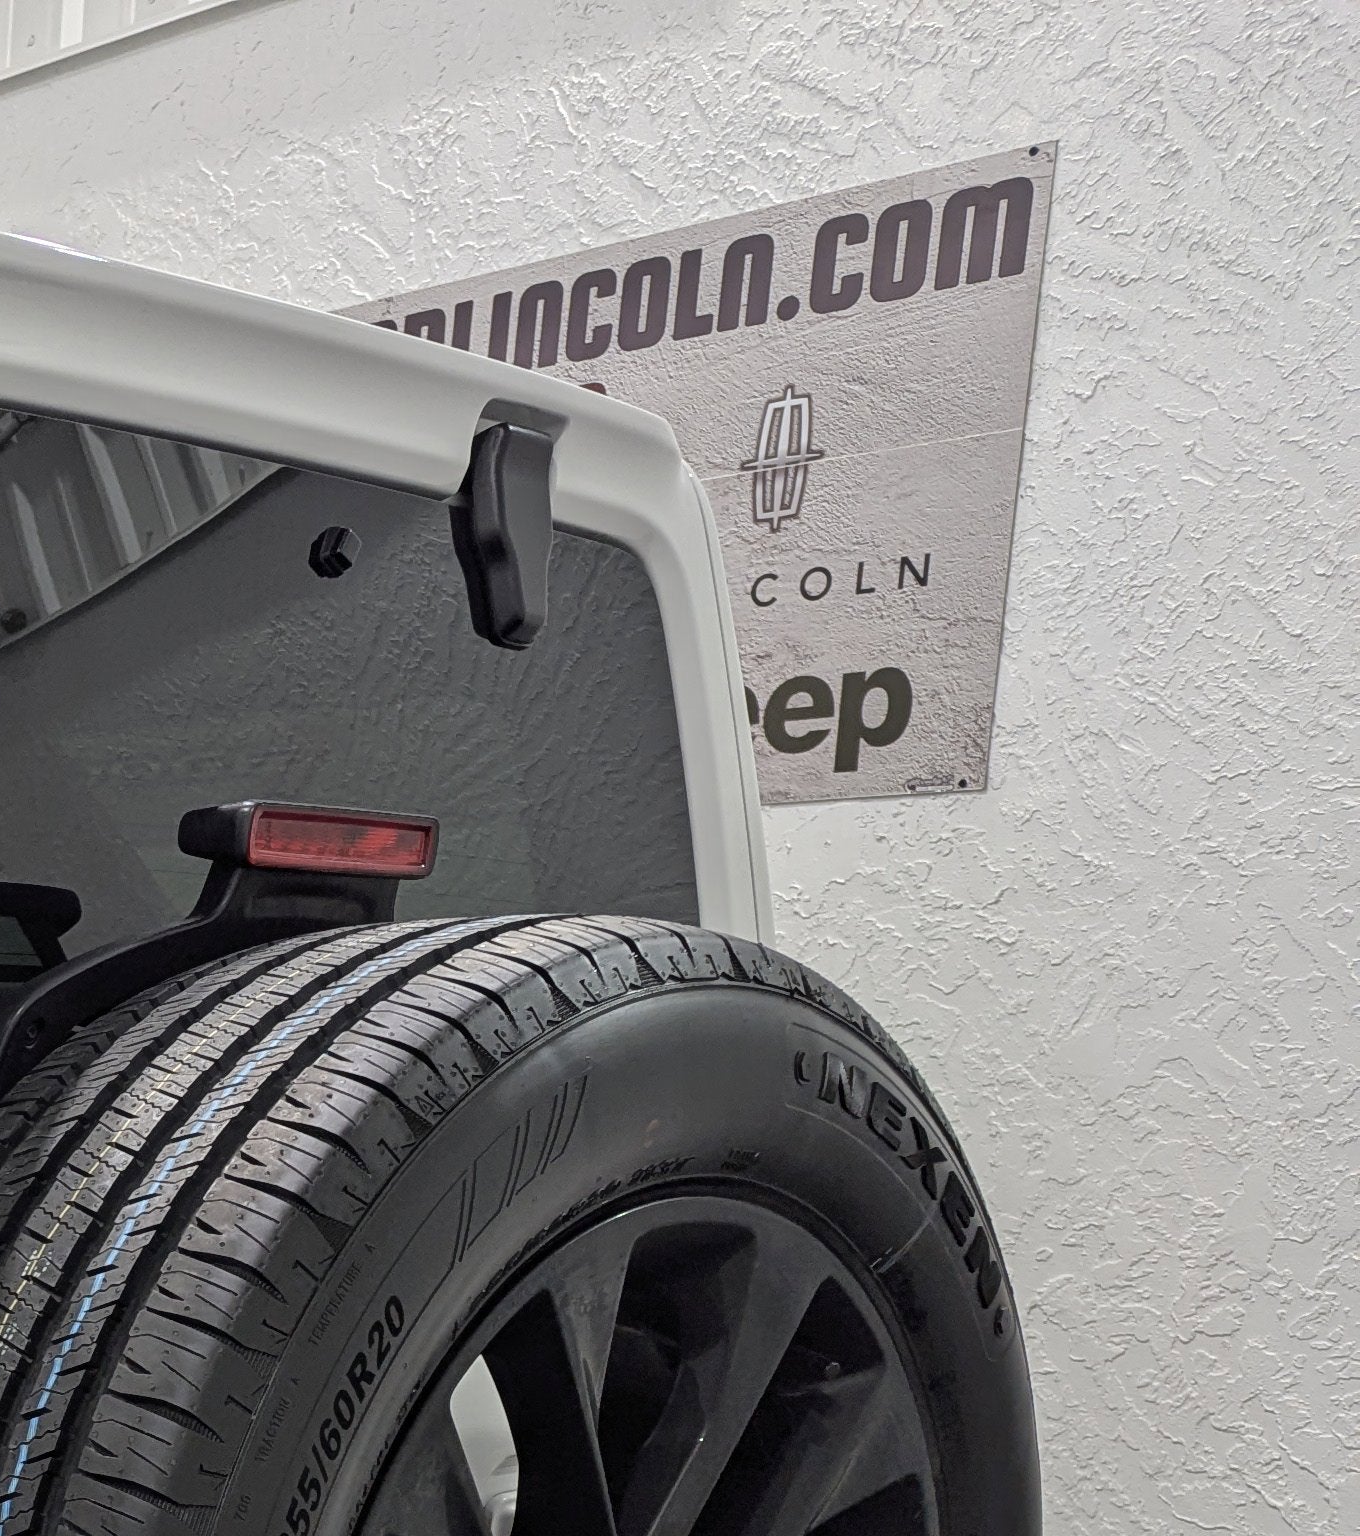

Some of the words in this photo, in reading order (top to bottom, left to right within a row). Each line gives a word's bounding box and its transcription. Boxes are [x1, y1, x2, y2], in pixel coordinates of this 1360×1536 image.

[750, 553, 931, 607] COLN
[744, 666, 913, 773] ep
[816, 1051, 1002, 1310] NEXEN
